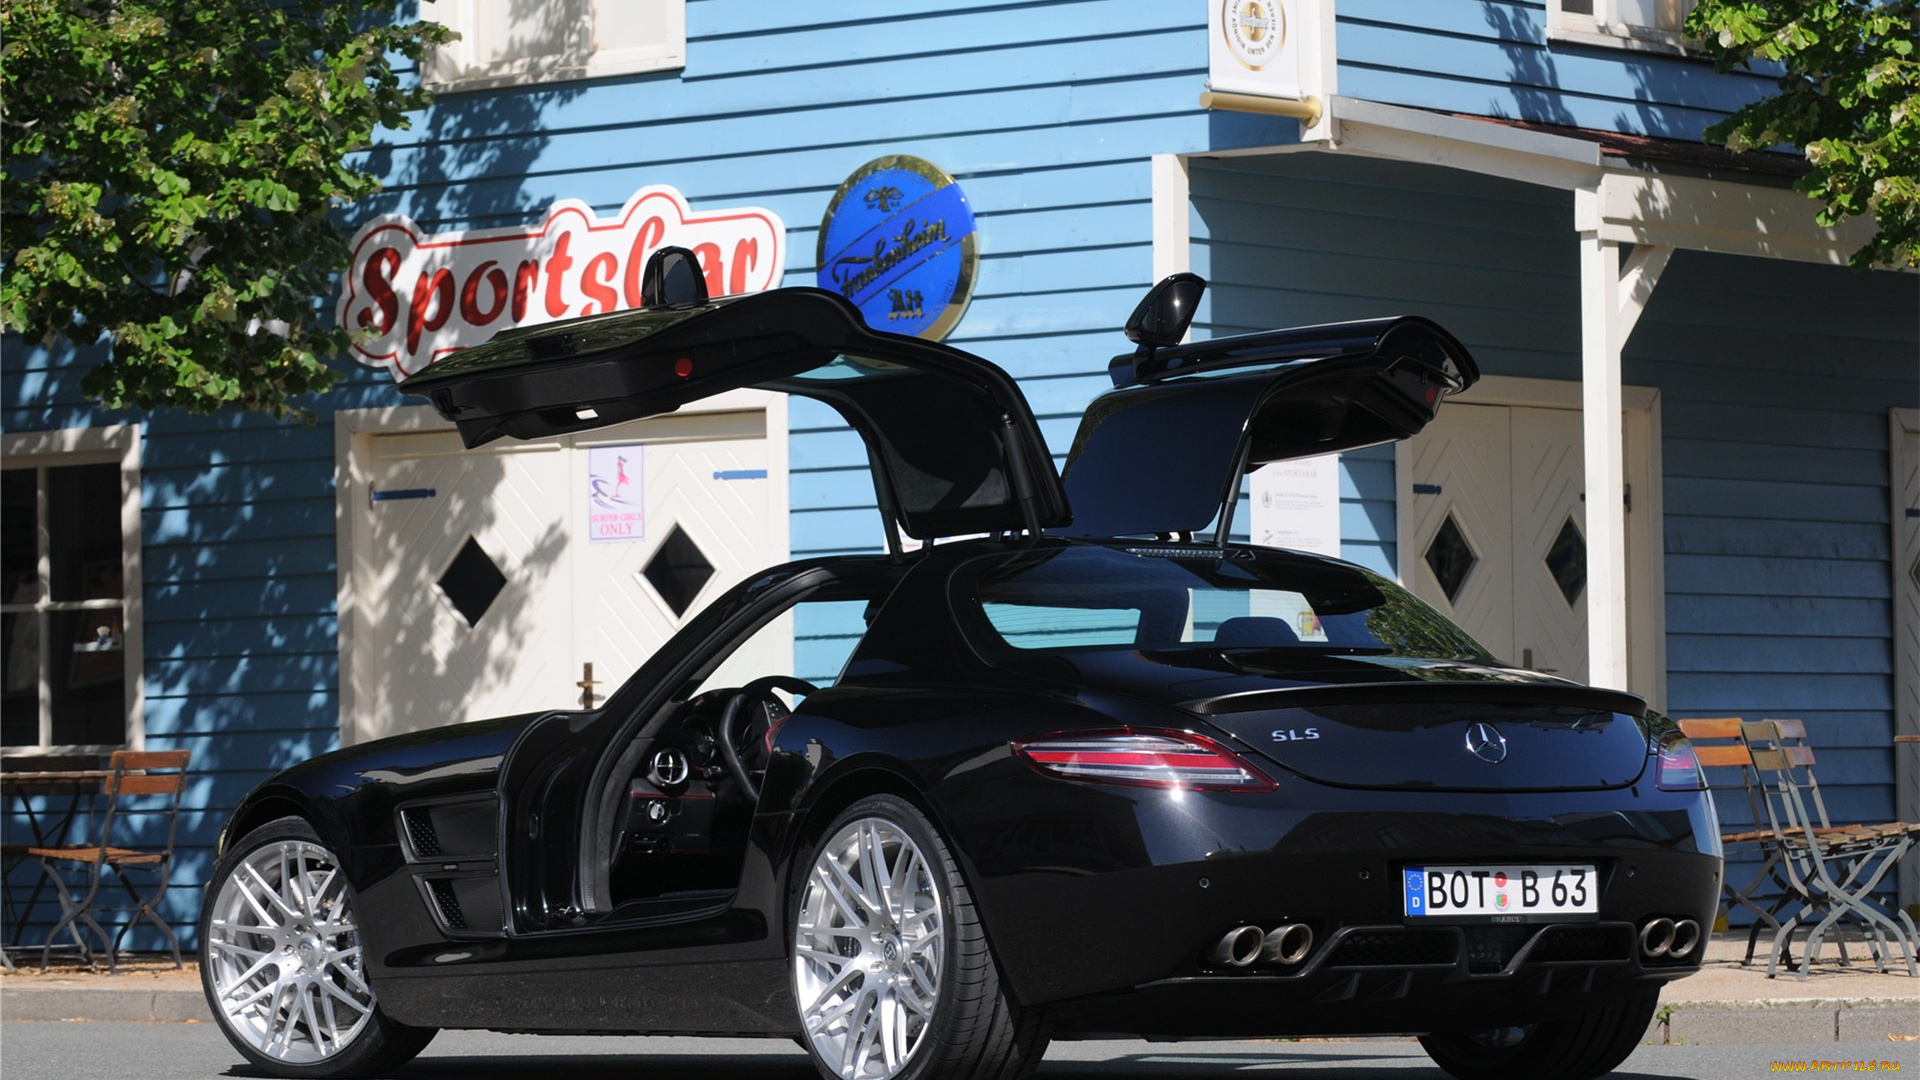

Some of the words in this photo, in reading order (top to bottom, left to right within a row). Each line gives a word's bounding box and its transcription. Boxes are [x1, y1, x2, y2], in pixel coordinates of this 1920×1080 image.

[831, 218, 952, 300] Frankenheim
[887, 288, 925, 322] Alt
[600, 523, 633, 535] ONLY
[620, 512, 642, 522] GIRLS
[1271, 727, 1320, 742] SLS
[1412, 897, 1420, 908] D
[1428, 870, 1490, 908] BOT
[1521, 870, 1540, 908] B
[1552, 869, 1587, 907] 63
